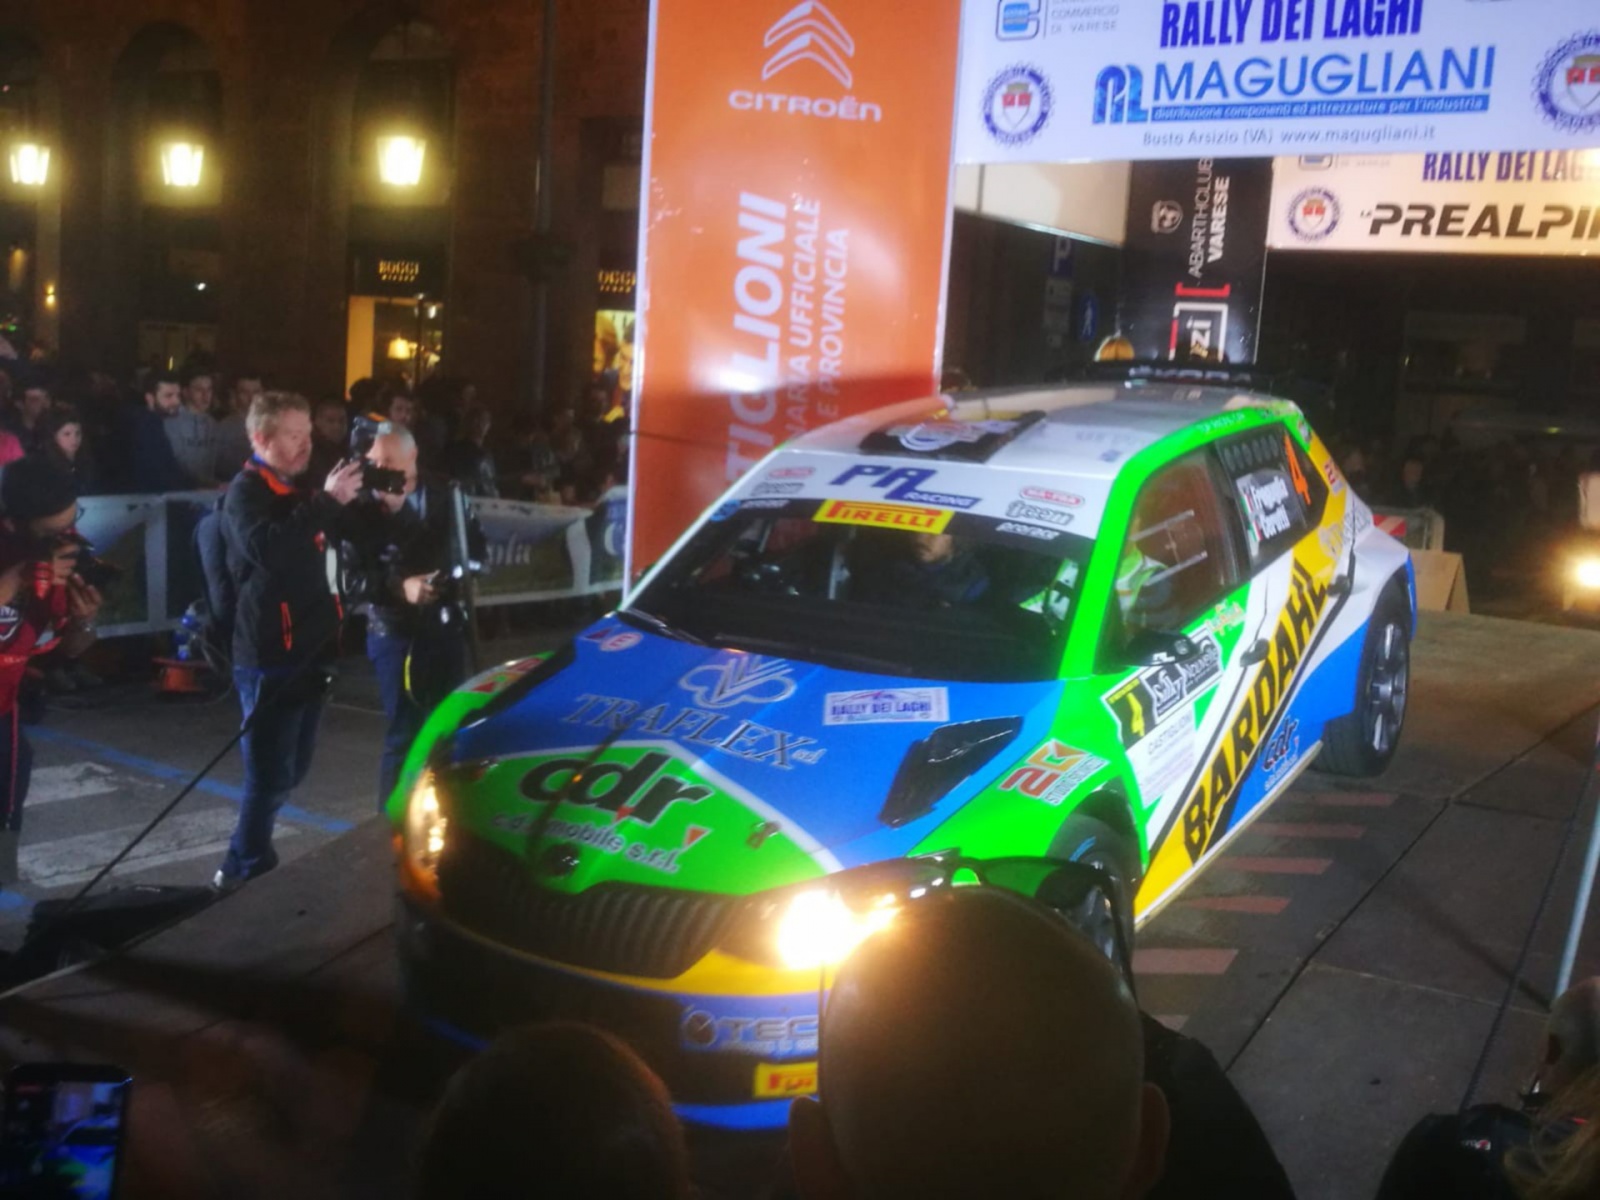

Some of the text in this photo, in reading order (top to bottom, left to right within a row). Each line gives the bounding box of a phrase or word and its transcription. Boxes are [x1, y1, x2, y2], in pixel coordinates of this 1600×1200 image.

[1160, 0, 1424, 48] RALLY DEI LAGHI
[1153, 46, 1495, 102] MAGUGLIANI
[1143, 125, 1436, 146] Busto Arsizio (VA) www.magugliani.it
[1422, 151, 1490, 182] RALLY
[1496, 150, 1536, 182] DEI
[1207, 176, 1231, 263] VARESE
[1369, 203, 1600, 239] PREALPI
[789, 195, 821, 348] UFFICIALE
[818, 229, 850, 395] PROVINCIA
[826, 501, 943, 529] PIRELLI
[562, 694, 817, 770] TRAFLEX
[1184, 557, 1327, 866] BARDAHL
[519, 752, 714, 826] cdr
